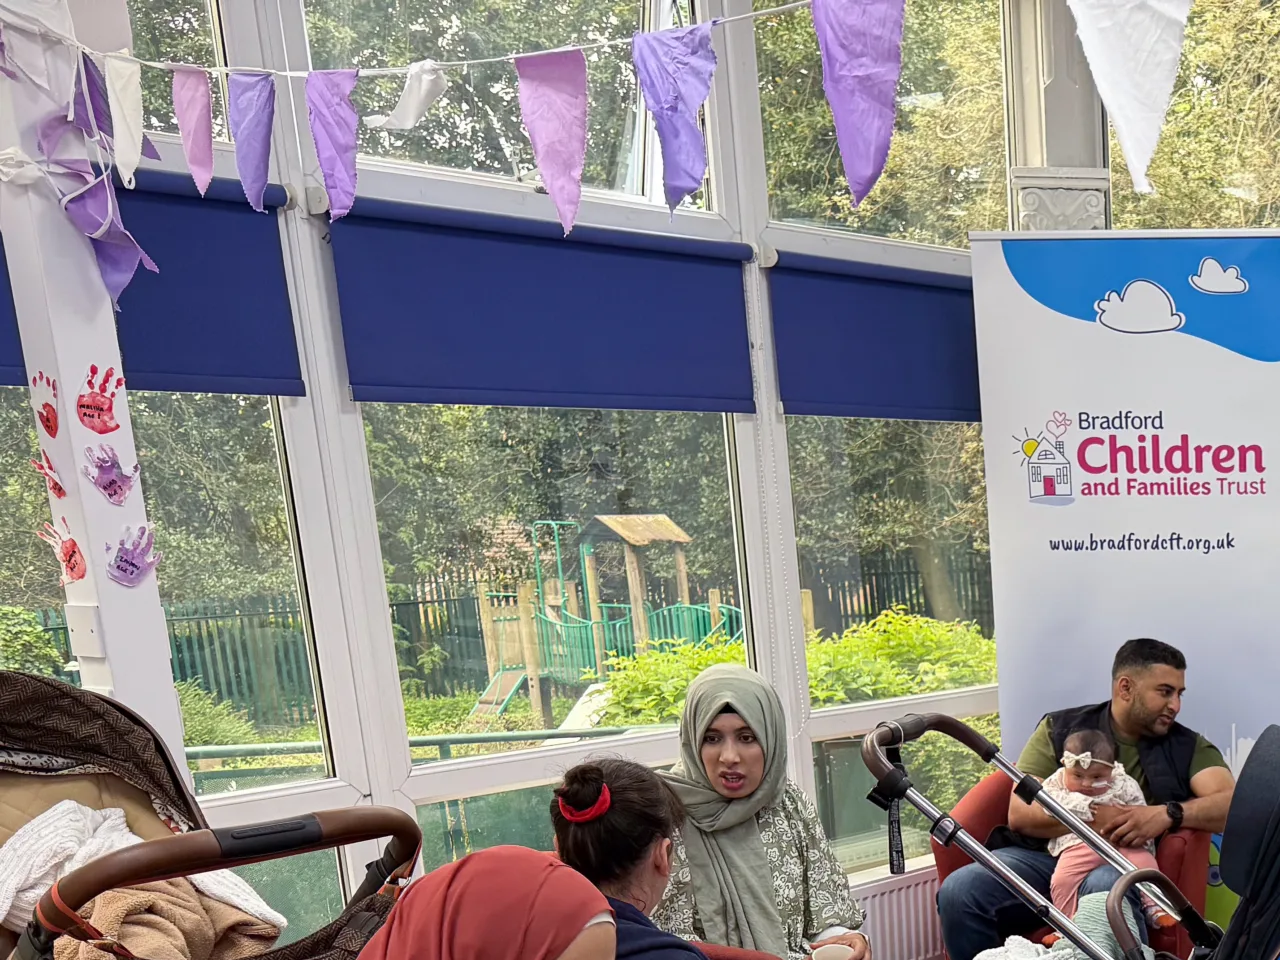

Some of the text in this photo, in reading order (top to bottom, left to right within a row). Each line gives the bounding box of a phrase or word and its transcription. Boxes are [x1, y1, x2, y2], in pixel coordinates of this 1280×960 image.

[1078, 411, 1164, 430] Bradford
[1077, 434, 1266, 474] Children
[1081, 477, 1267, 496] and Families Trust
[1049, 533, 1235, 554] www.bradfordcft.org.uk
